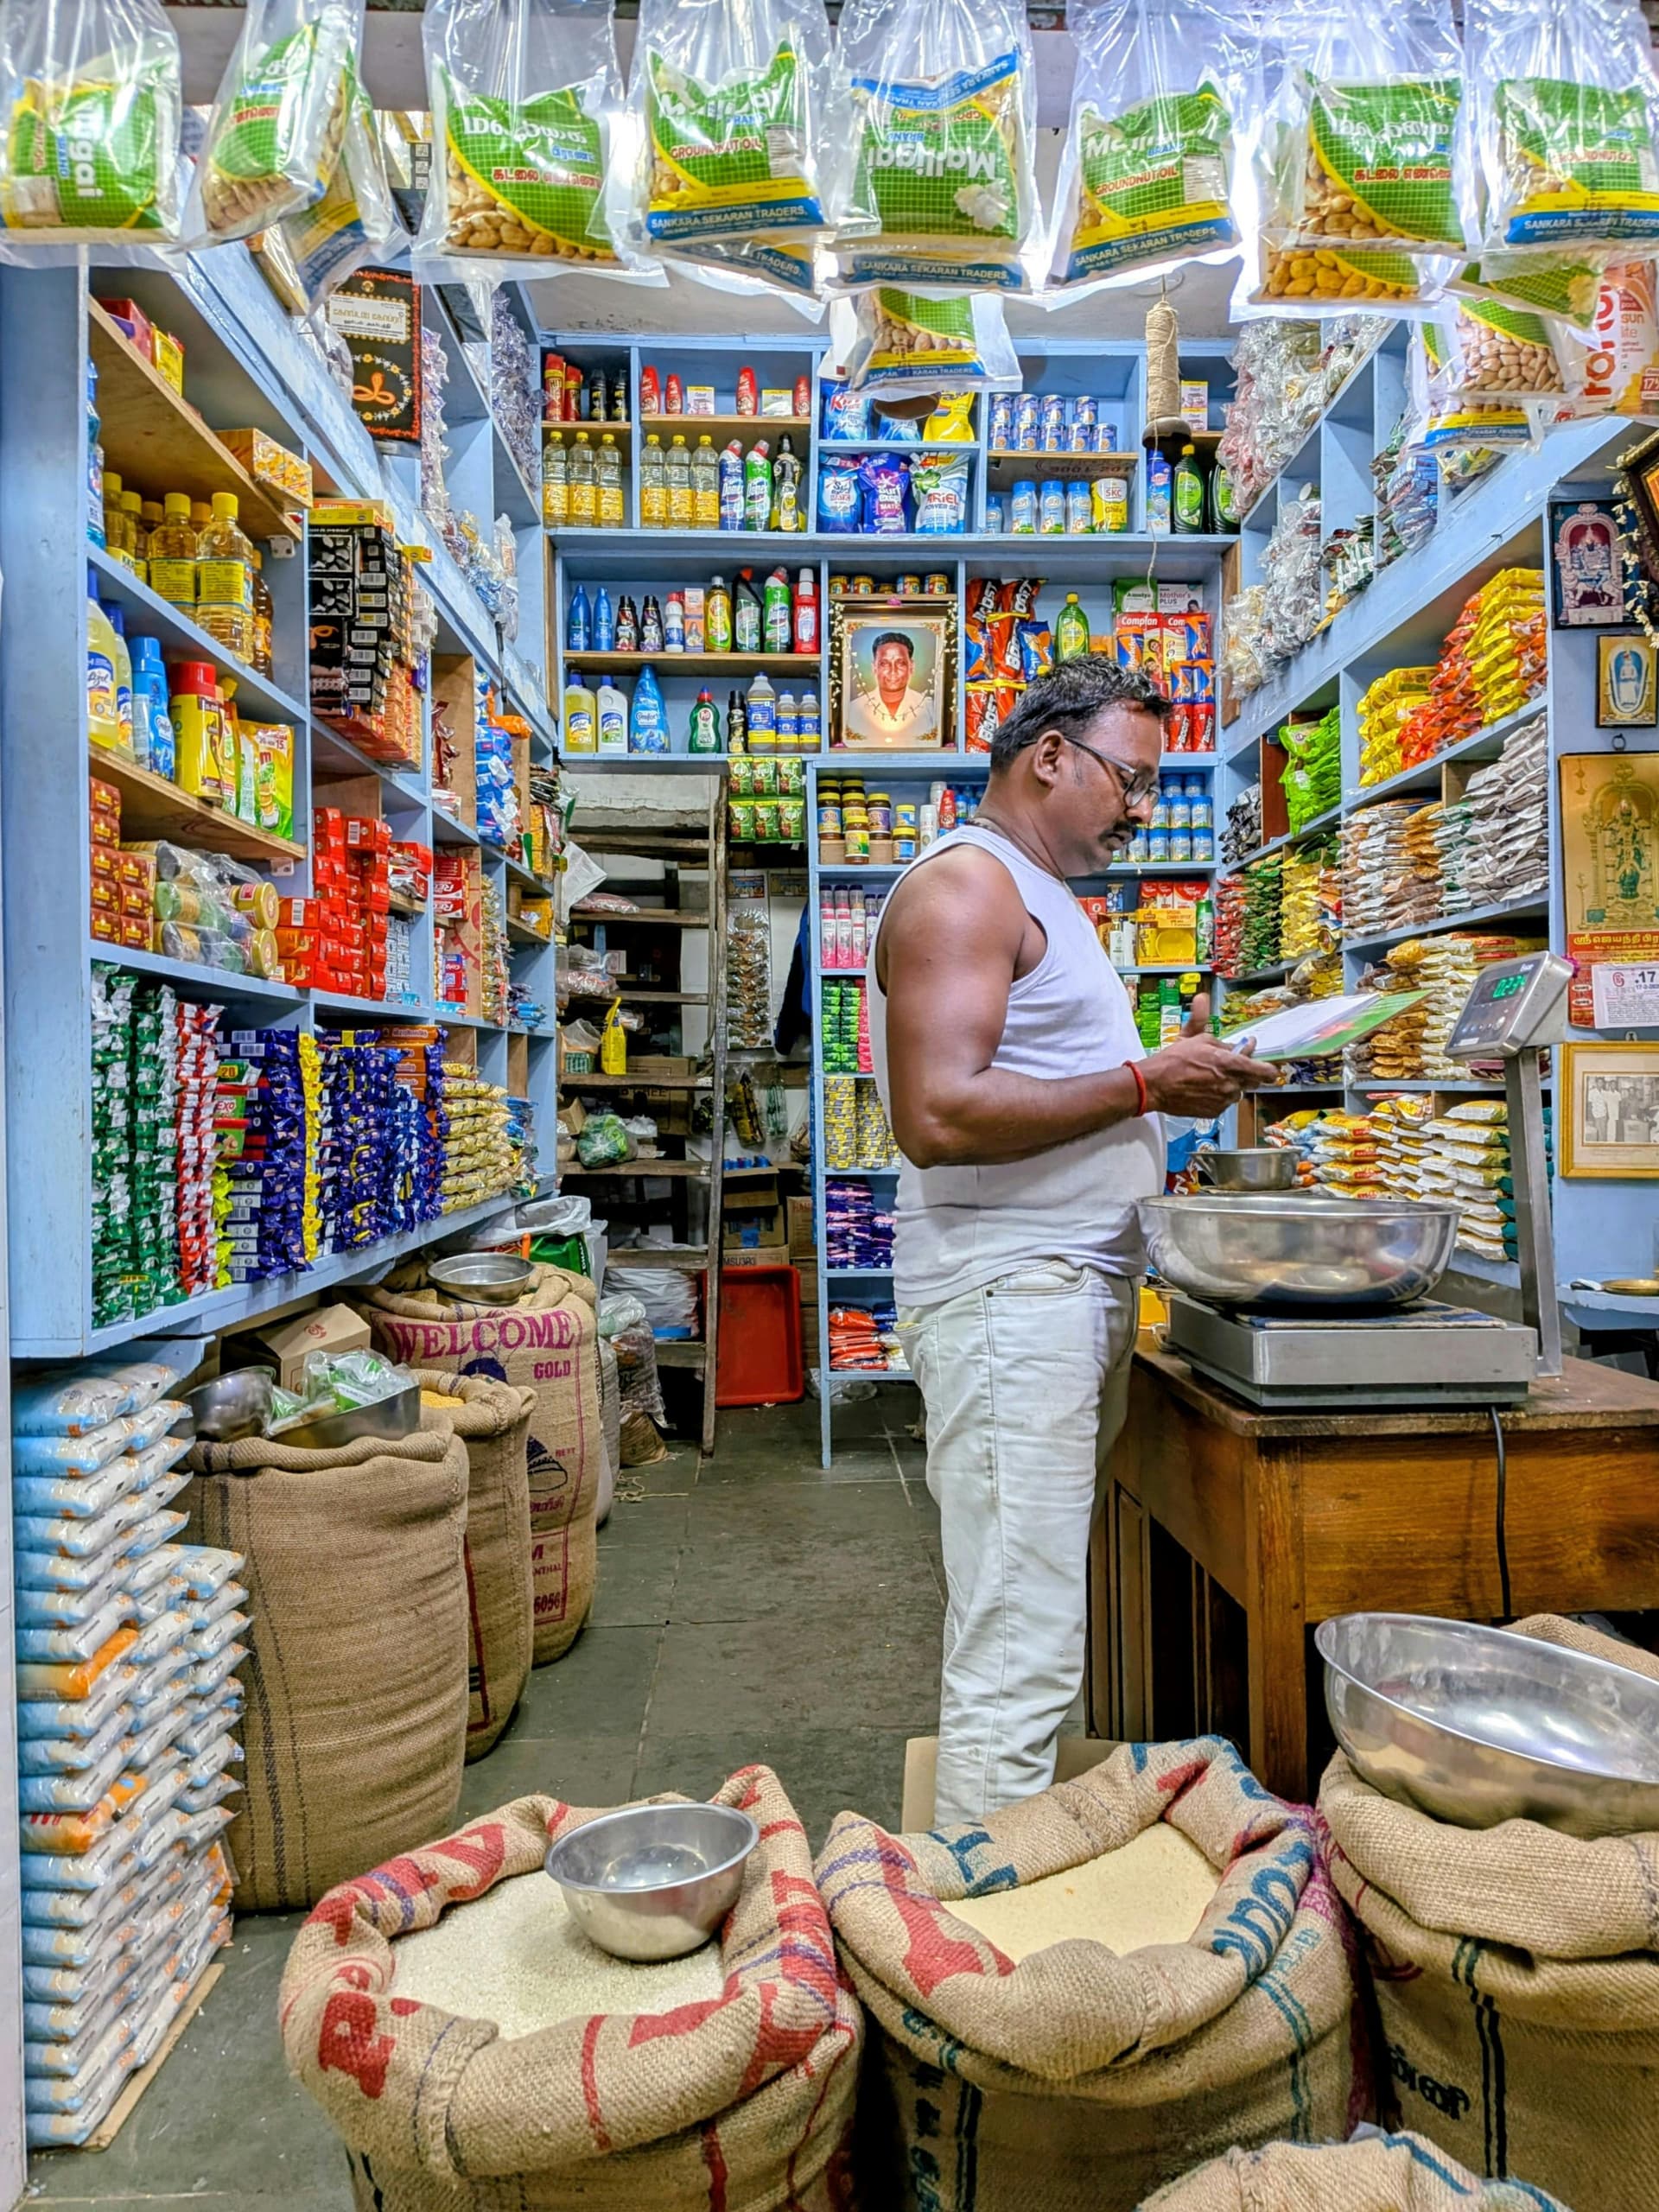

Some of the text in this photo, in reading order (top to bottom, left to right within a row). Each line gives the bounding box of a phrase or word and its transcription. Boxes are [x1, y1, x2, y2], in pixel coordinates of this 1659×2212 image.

[741, 137, 763, 151] OIL
[1095, 167, 1179, 196] GROUNDNUT OIL
[1354, 167, 1401, 182] கடலை
[652, 213, 702, 229] SANKARA
[702, 210, 754, 226] SEKARAN
[1524, 219, 1572, 230] SANKARA
[1075, 246, 1119, 267] SANKARA
[1120, 236, 1168, 255] SEKARAN
[862, 261, 908, 273] SANKARA
[910, 263, 959, 276] SEKARAN
[1620, 313, 1645, 325] sun
[1121, 616, 1159, 628] Complan
[220, 1065, 238, 1079] 20
[215, 1100, 236, 1112] EXO
[384, 1309, 576, 1365] WELCOME
[532, 1360, 572, 1380] GOLD
